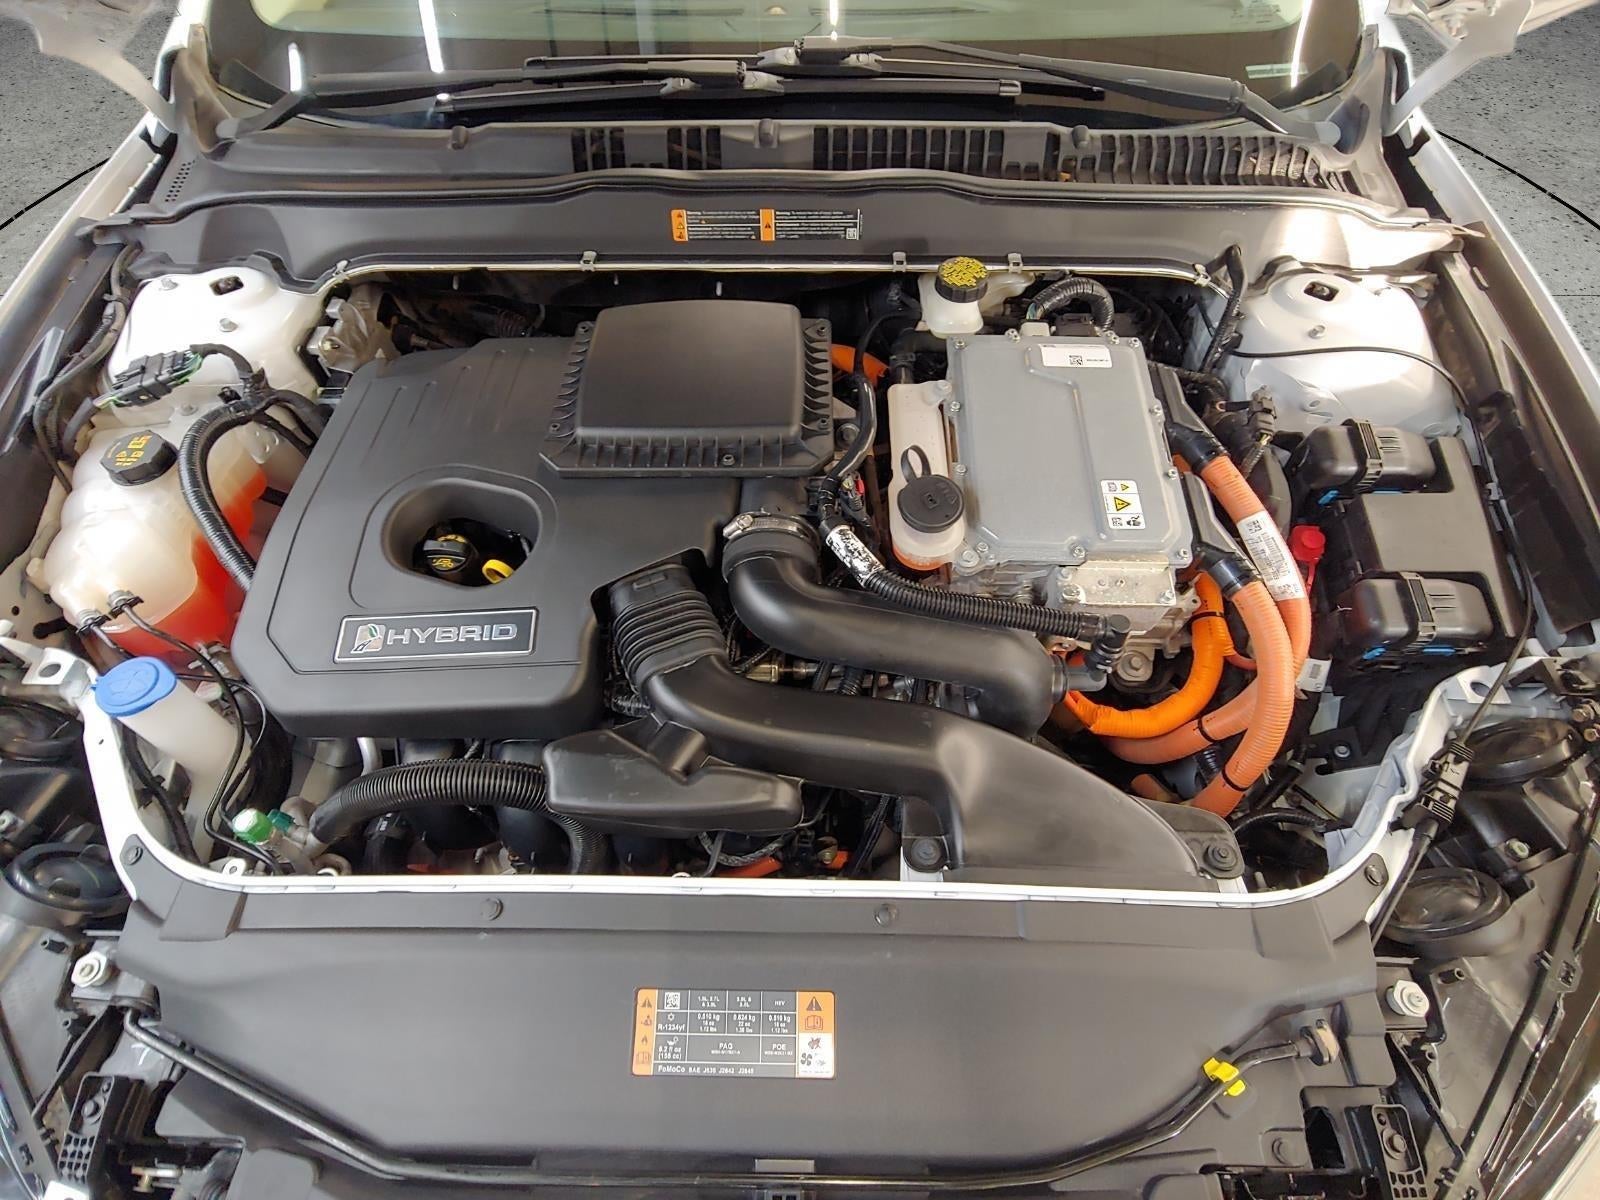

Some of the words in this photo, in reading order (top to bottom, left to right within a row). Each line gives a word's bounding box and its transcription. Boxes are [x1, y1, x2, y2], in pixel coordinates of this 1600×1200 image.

[387, 623, 518, 645] HYBRID
[748, 1014, 756, 1022] kg
[783, 1015, 791, 1023] kg
[657, 1023, 685, 1032] R-1234yf
[772, 1043, 787, 1051] POE
[657, 1065, 686, 1073] FoMoCo
